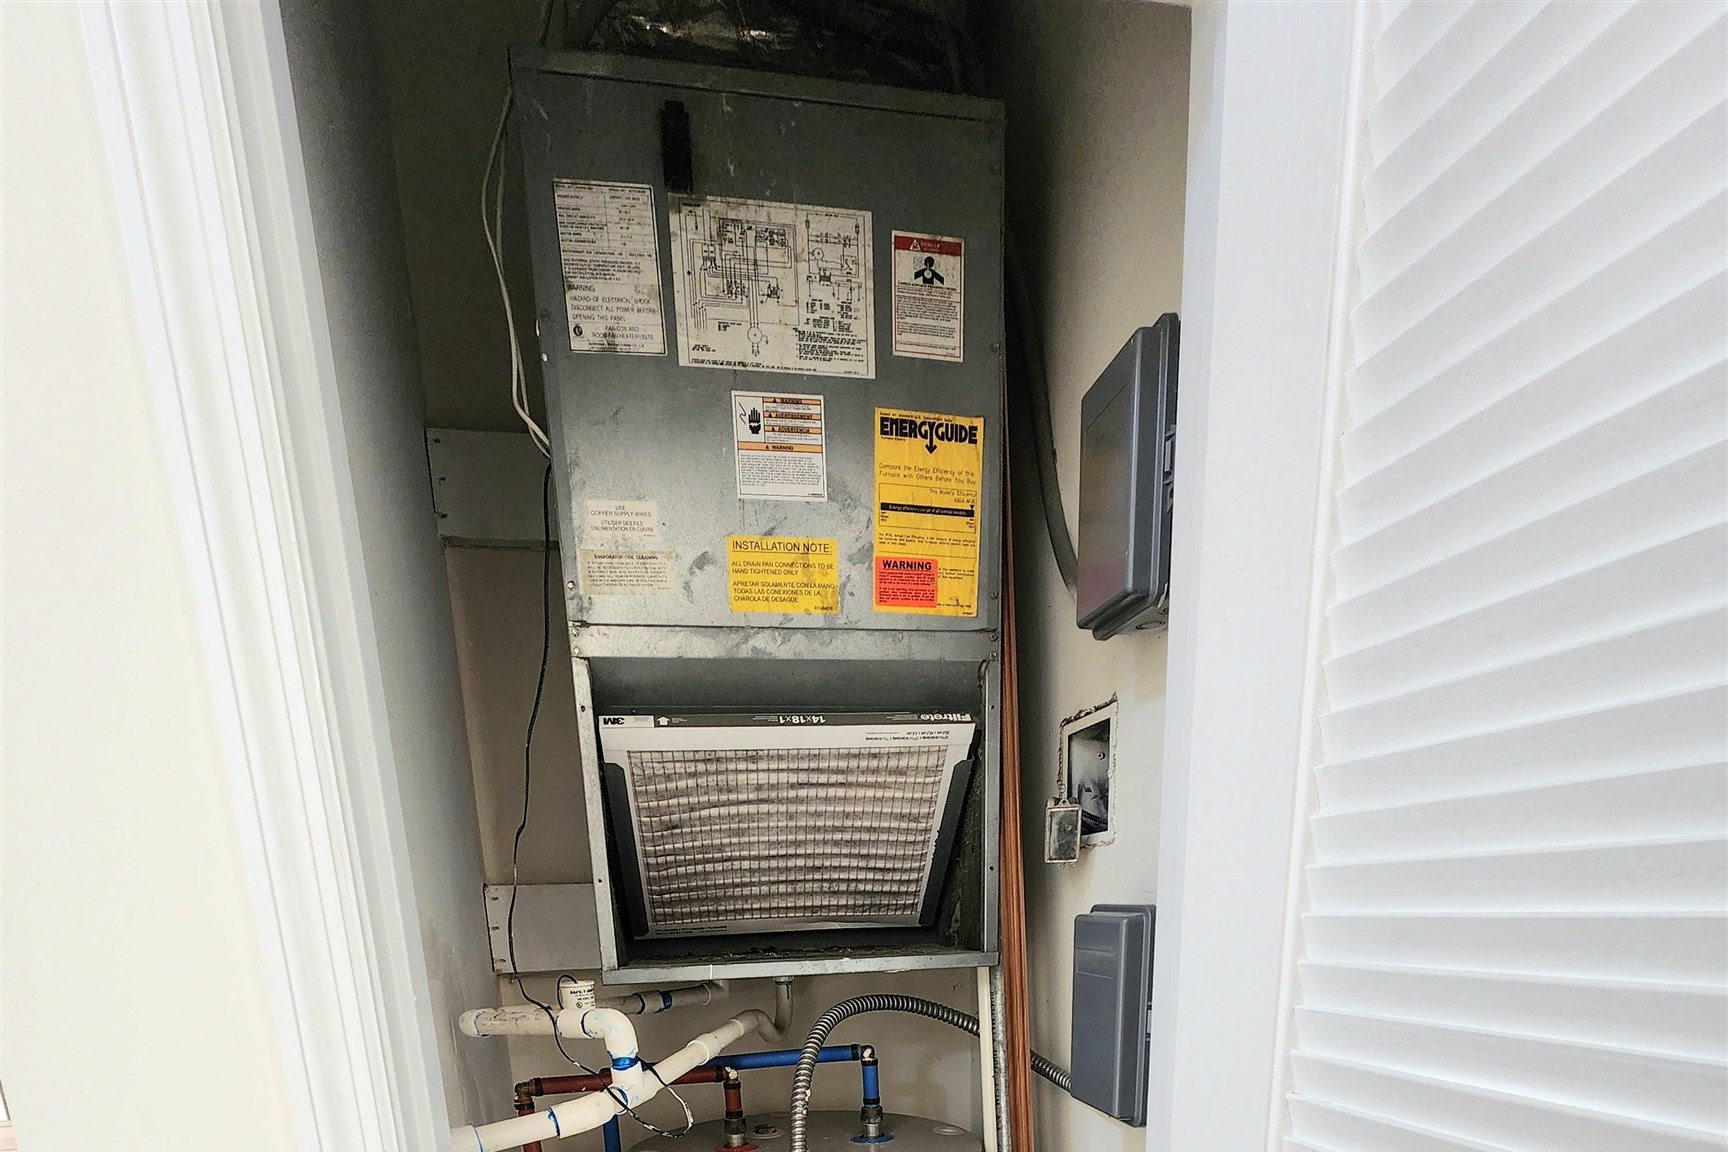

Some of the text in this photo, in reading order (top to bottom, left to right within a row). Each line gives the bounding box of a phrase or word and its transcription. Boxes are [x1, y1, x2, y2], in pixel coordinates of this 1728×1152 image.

[571, 304, 604, 312] DISCONNECT
[880, 416, 978, 445] ENERGYGUIDE
[879, 462, 901, 470] Compare
[914, 465, 931, 475] Energy
[932, 466, 955, 476] Efficiency
[916, 473, 933, 481] Others
[935, 475, 952, 483] Before
[966, 478, 976, 486] Buy
[732, 540, 833, 553] INSTALLATION NOTE:
[882, 559, 932, 571] WARNING
[603, 717, 625, 725] 3M
[779, 715, 826, 724] 14x18x1
